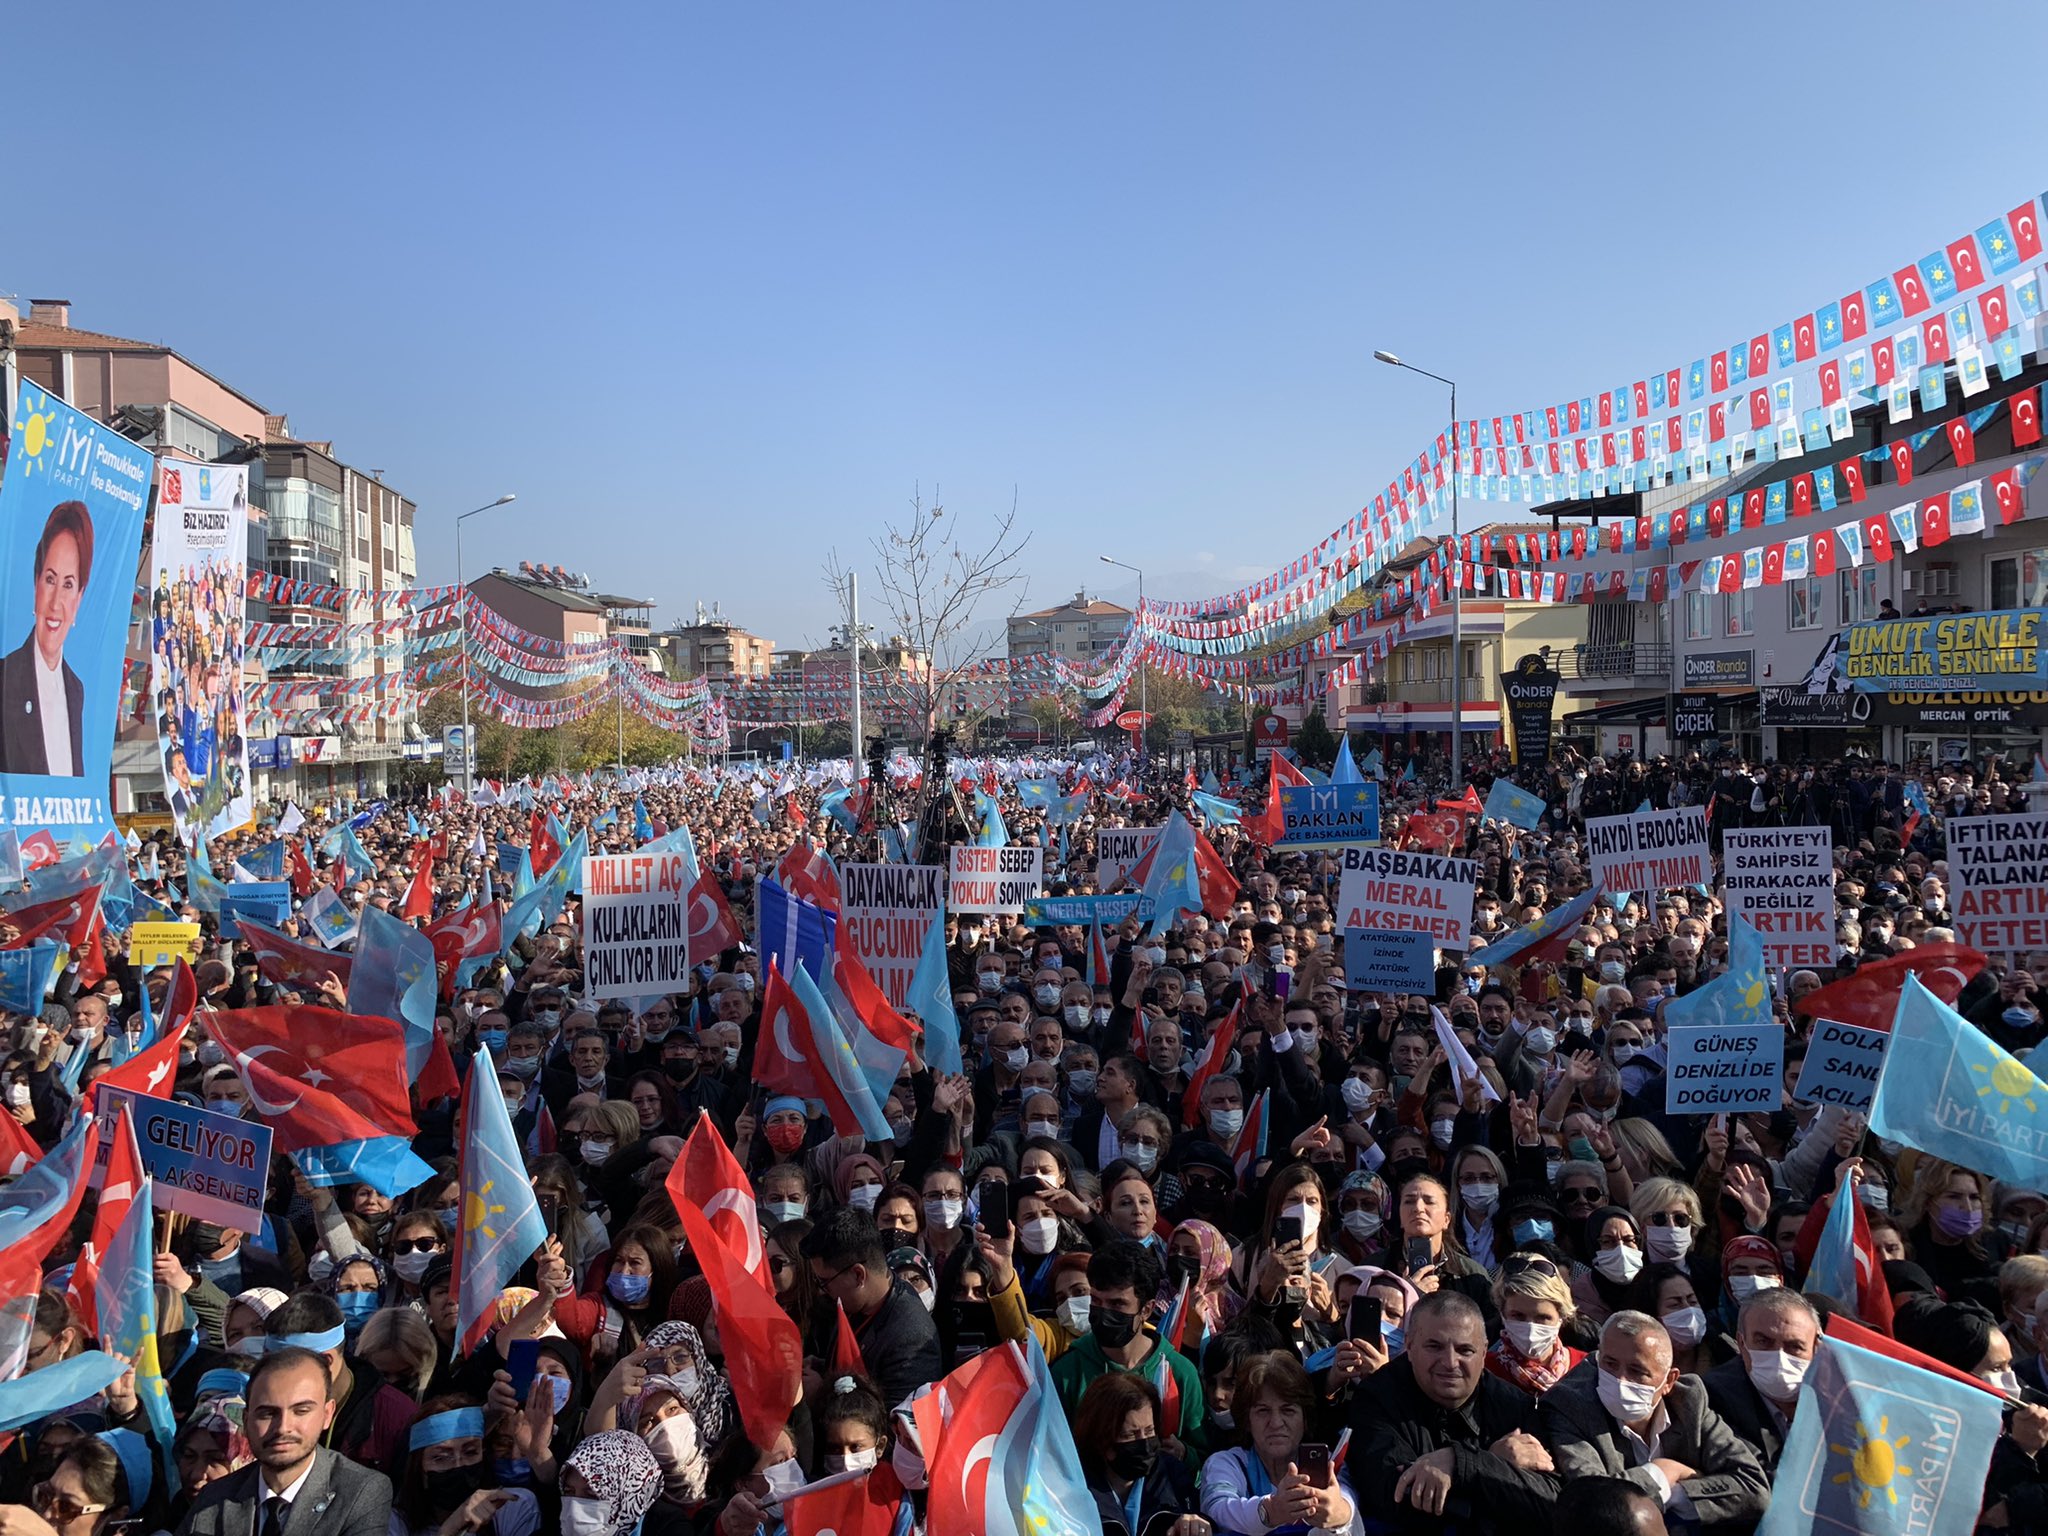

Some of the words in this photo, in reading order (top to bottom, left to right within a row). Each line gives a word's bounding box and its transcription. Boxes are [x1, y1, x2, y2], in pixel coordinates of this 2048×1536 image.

[96, 442, 145, 483] Pamukkale
[1849, 621, 1931, 656] UMUT
[1936, 612, 2040, 651] SENLE
[1686, 656, 1715, 674] ÖNDER
[1717, 659, 1747, 673] Branda
[1510, 681, 1554, 698] ÖNDER
[1516, 700, 1549, 709] Branda
[1920, 710, 1966, 721] MERCAN
[1974, 707, 2011, 721] OPTİK
[1287, 811, 1364, 829] BAKLAN
[1281, 832, 1302, 842] LÇE
[1305, 827, 1371, 841] BAŞKANLIĞI
[1589, 816, 1634, 856] HAYDİ
[1636, 810, 1707, 851] ERDOĞAN
[1725, 830, 1827, 849] TÜRKİYE'Yİ
[999, 849, 1035, 873] SEBEP
[1102, 836, 1138, 864] BIÇAK
[1736, 851, 1819, 869] SAHİPSİZ
[658, 856, 682, 901] AÇ
[1344, 848, 1477, 884] BAŞBAKAN
[1603, 855, 1646, 893] VAKİT
[1649, 855, 1702, 888] TAMAM
[846, 867, 939, 909] DAYANACAK
[952, 880, 997, 905] YOKLUK
[1726, 874, 1831, 889] BIRAKACAK
[1366, 880, 1447, 911] MERAL
[1744, 892, 1814, 909] DEĞİLİZ
[1046, 902, 1091, 919] MERAL
[593, 903, 681, 944] KULAKLARIN
[1956, 919, 2048, 948] YETE
[1762, 944, 1832, 964] ETER
[589, 946, 654, 996] ÇINLIYOR
[658, 944, 686, 981] MU?
[1369, 963, 1410, 973] ATATÜRK
[1693, 1034, 1758, 1056] GÜNEŞ
[1822, 1026, 1885, 1052] DOLA
[1676, 1085, 1771, 1104] DOĞUYOR
[147, 1114, 256, 1170] GELİYOR
[1980, 1113, 2048, 1152] PART
[164, 1166, 260, 1208] AKŞENER
